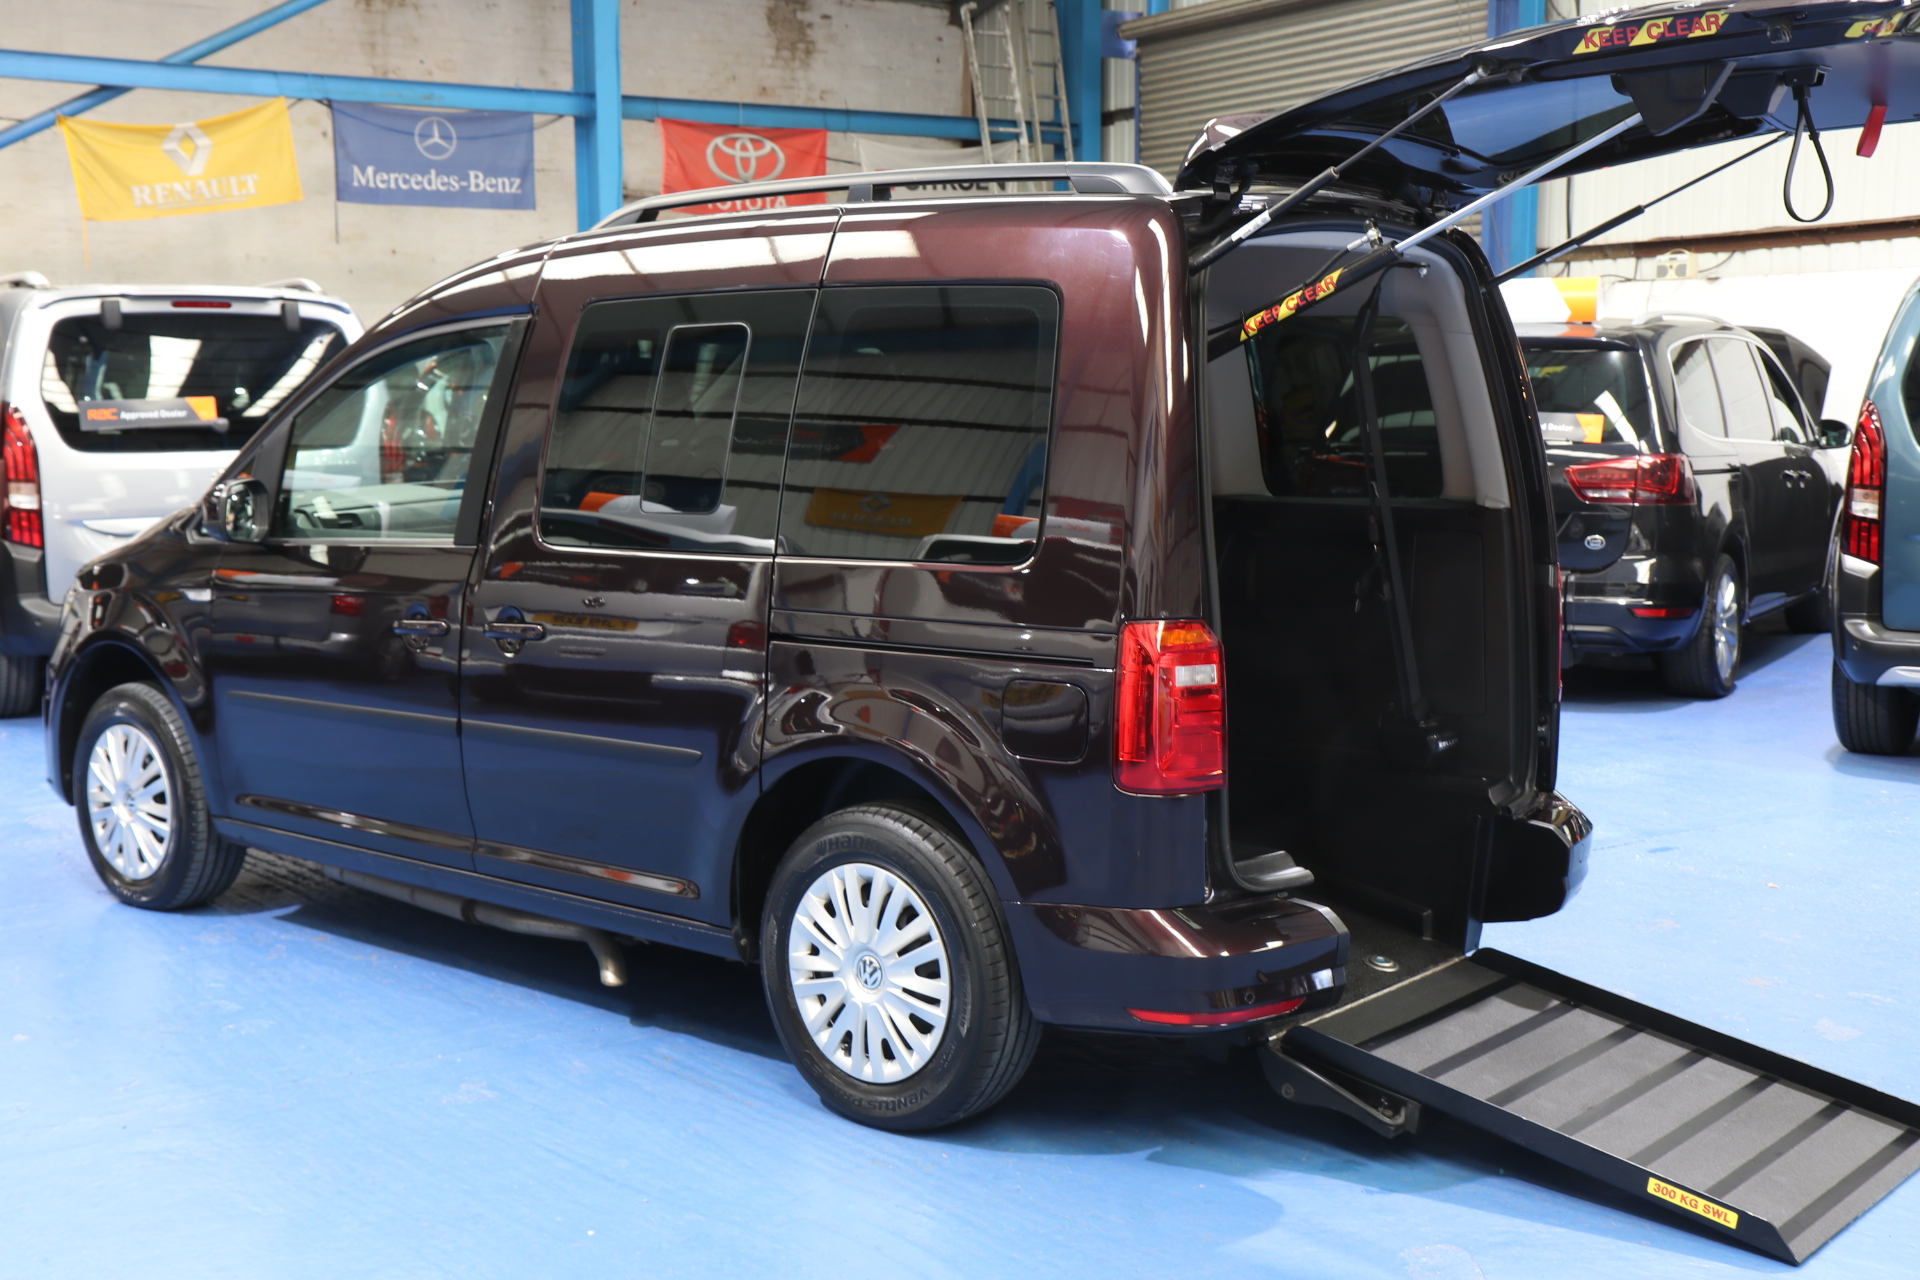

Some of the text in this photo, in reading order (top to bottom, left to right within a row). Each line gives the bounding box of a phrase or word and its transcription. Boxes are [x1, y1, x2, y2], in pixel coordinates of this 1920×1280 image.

[1583, 13, 1721, 49] KEEP CLEAR
[130, 173, 259, 207] RENAULT
[352, 164, 522, 193] Mercedes-Benz
[1243, 275, 1338, 335] KEEP CLEAR
[120, 410, 159, 420] Approved
[160, 409, 188, 419] Dealer
[1653, 1183, 1731, 1224] 300 KG SWL
